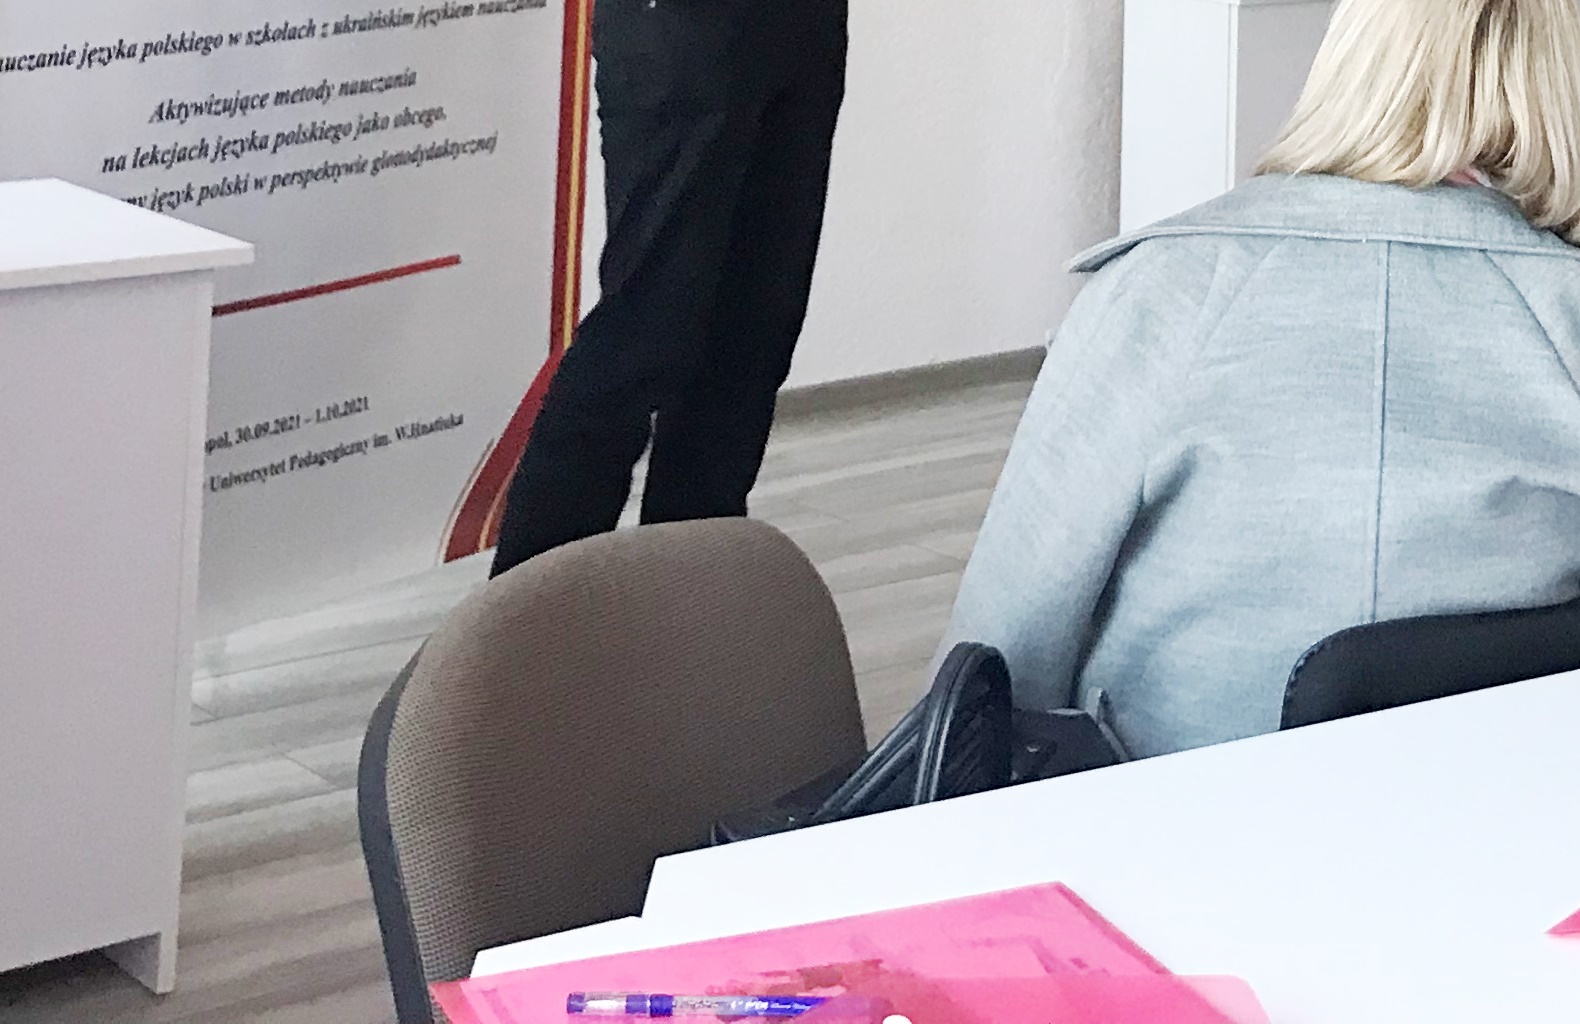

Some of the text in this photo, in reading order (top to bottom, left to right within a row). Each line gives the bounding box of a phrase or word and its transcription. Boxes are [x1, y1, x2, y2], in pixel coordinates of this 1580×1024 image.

[76, 38, 137, 69] języka
[139, 30, 223, 63] polskiego
[228, 32, 242, 45] w
[245, 18, 316, 47] szkołach
[332, 8, 415, 35] ukraińskim
[414, 1, 474, 28] językiem
[149, 66, 416, 124] Aktywizujące metody nauczania
[102, 156, 126, 173] na
[132, 137, 209, 169] lekcjach
[210, 129, 269, 163] języka
[270, 120, 352, 154] polskiego
[352, 111, 390, 141] jako
[150, 182, 194, 212] język
[197, 173, 249, 206] polski
[254, 176, 267, 190] w
[268, 154, 368, 194] perspektywie
[235, 413, 300, 444] 30.09.2021
[315, 396, 369, 424] 1.10.2021
[210, 461, 285, 492] Uniwersytet
[289, 438, 368, 470] Pedagogiczny
